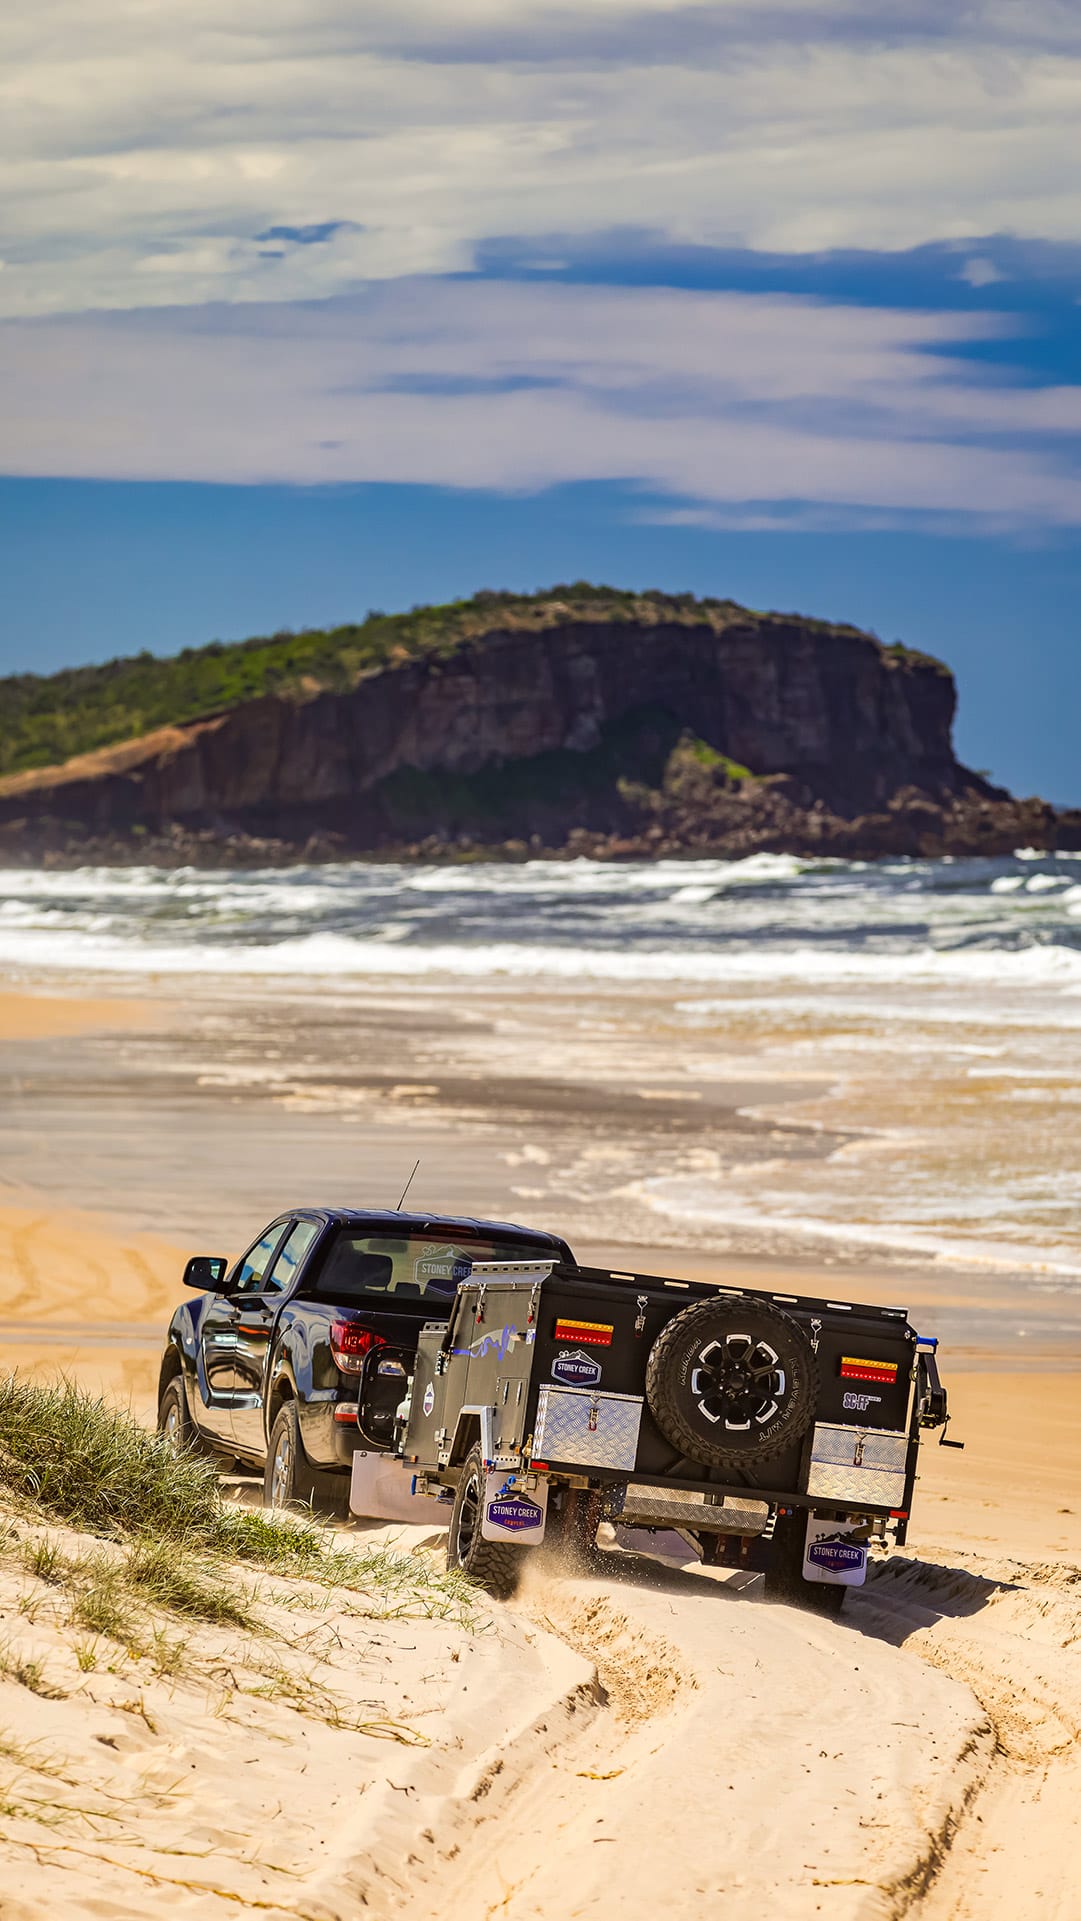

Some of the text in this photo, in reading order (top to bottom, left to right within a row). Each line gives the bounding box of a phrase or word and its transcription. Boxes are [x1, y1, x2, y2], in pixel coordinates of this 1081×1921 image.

[421, 1263, 472, 1277] STONEY CREE
[557, 1363, 597, 1376] STONEY CREEK
[493, 1505, 538, 1518] STONEY CREEK
[813, 1546, 859, 1560] STONEY CREEK
